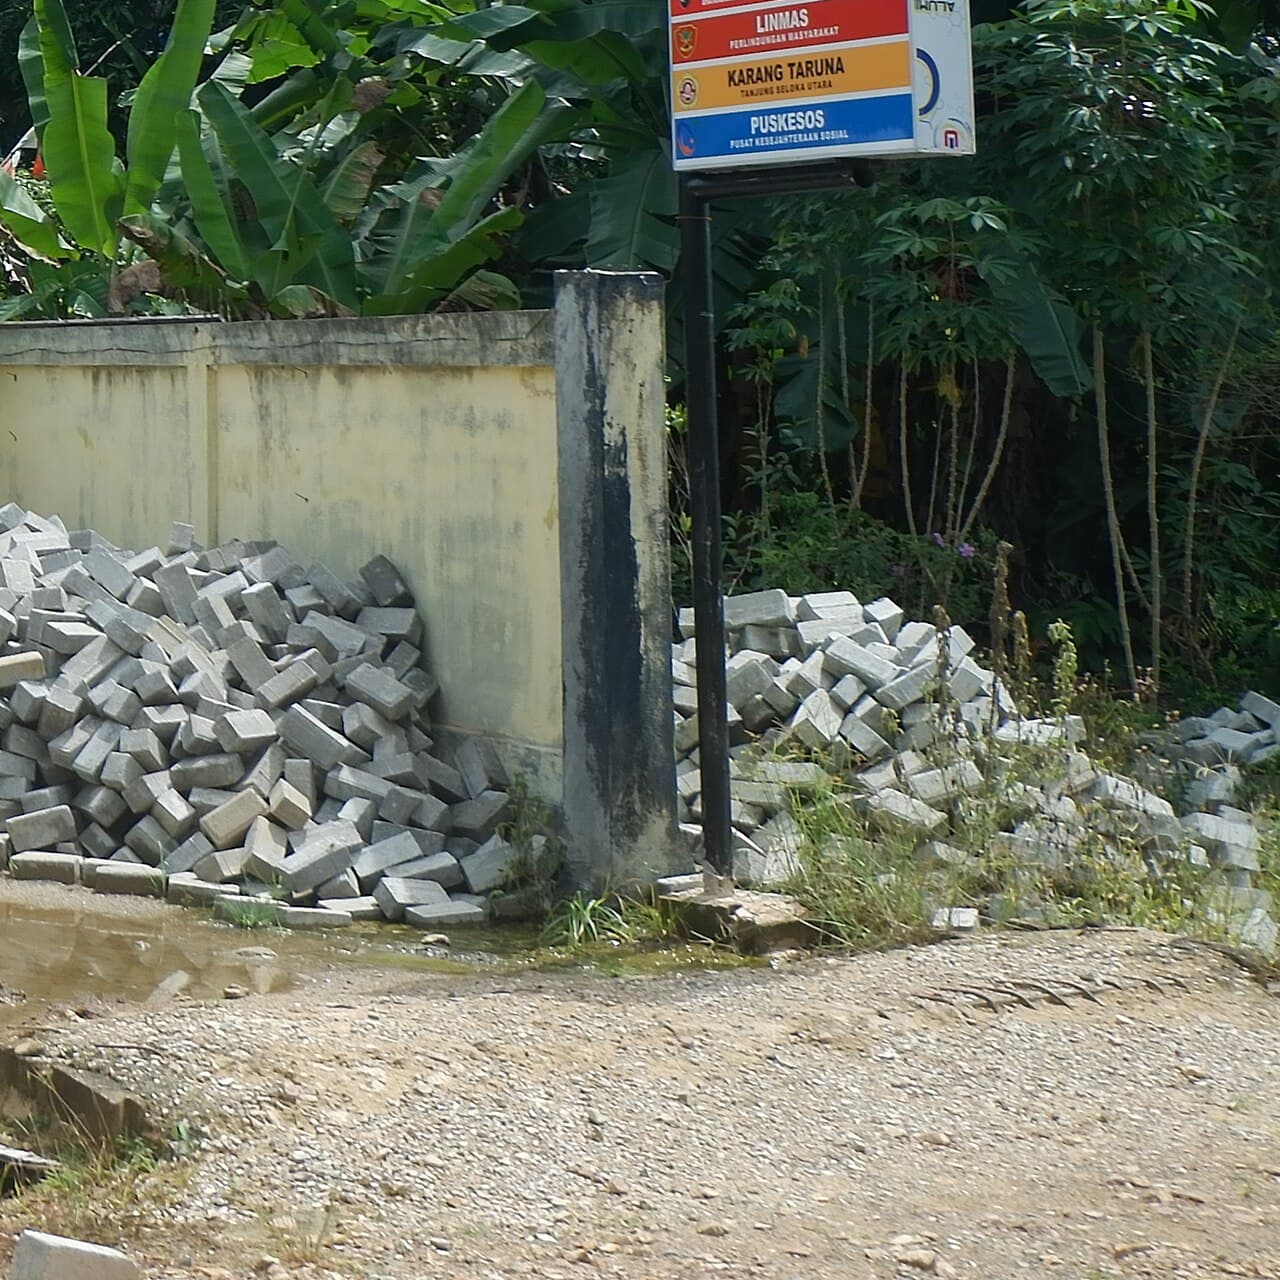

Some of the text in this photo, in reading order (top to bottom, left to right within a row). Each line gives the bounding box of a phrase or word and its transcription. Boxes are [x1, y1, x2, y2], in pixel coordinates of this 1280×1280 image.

[756, 8, 809, 34] LINMAS
[729, 25, 839, 50] PERLINDUNGAN MASYARAKAT
[728, 56, 845, 88] KARANG TARUNA
[740, 80, 833, 99] TANJUNG SELOKA UTARA
[751, 109, 825, 135] PUSKESOS
[730, 129, 848, 150] PUSAT KESEJAHTERAAN SOSIAL
